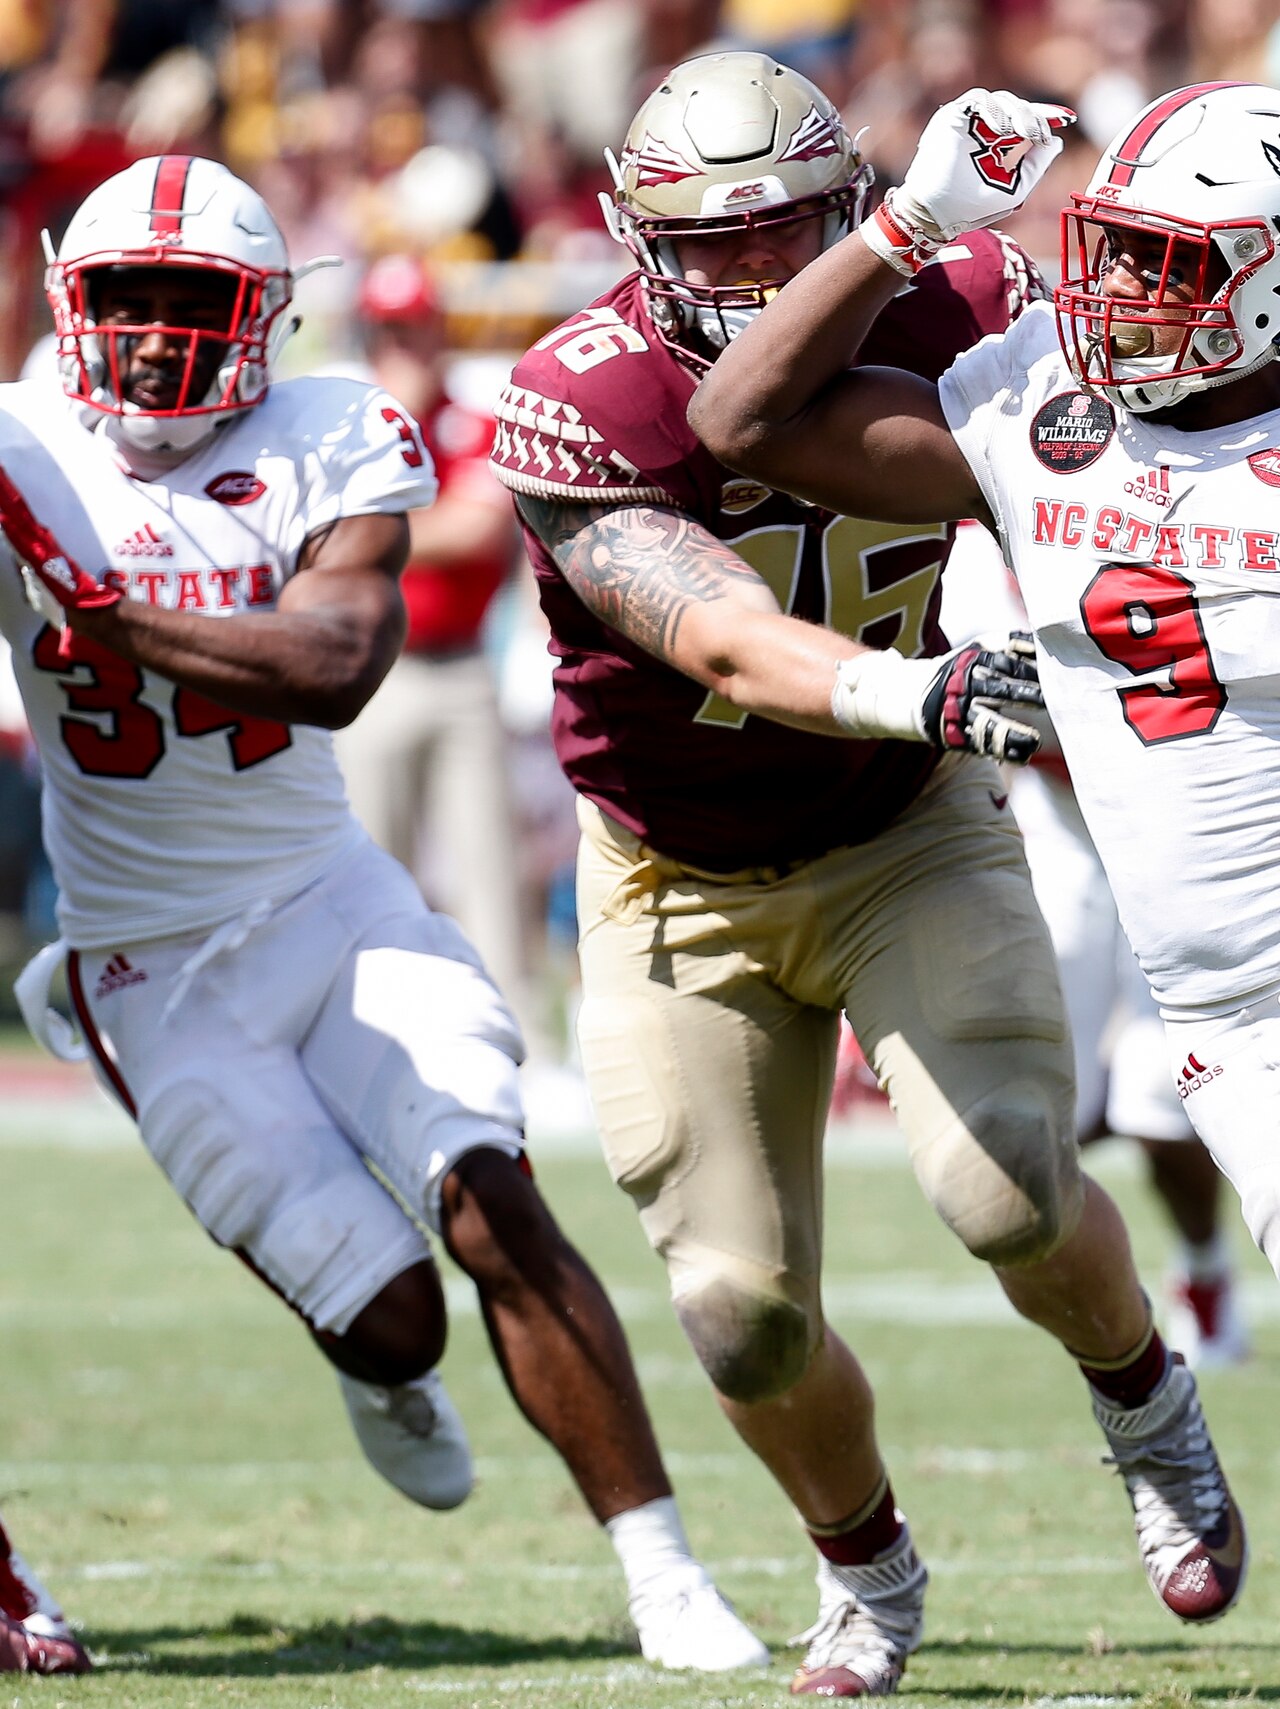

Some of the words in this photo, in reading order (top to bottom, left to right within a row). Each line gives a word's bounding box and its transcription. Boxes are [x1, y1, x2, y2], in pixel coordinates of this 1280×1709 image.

[725, 183, 763, 200] ACC
[1096, 186, 1121, 200] ACC
[533, 306, 650, 375] 76
[1037, 426, 1108, 443] WILLIAMS
[1055, 416, 1094, 428] MARIO
[381, 408, 423, 467] 3
[212, 474, 261, 496] ACC
[722, 486, 765, 502] ACC
[1123, 481, 1173, 509] adidas
[1032, 496, 1089, 549] NC
[102, 563, 275, 611] STATE
[1079, 561, 1229, 748] 9
